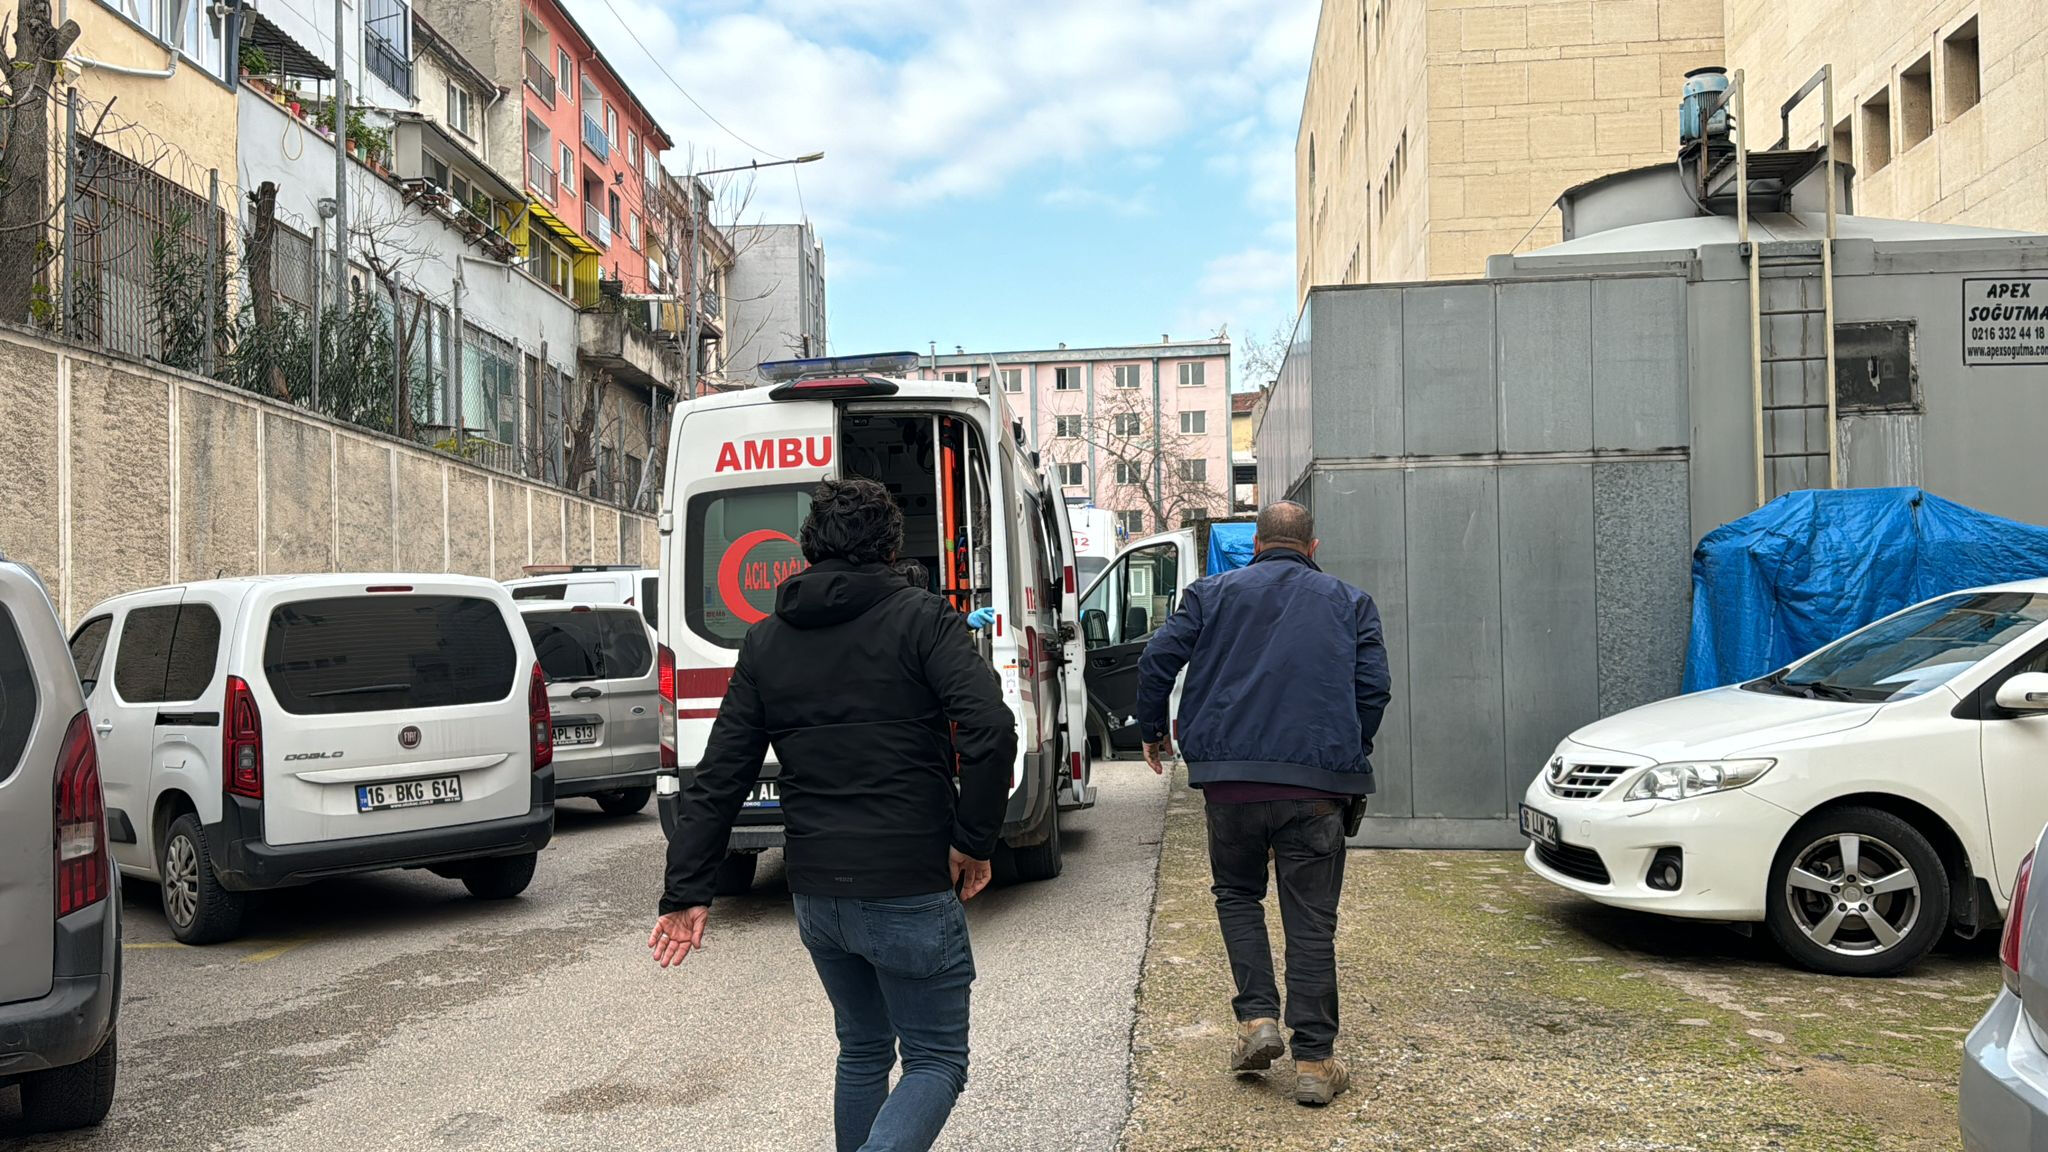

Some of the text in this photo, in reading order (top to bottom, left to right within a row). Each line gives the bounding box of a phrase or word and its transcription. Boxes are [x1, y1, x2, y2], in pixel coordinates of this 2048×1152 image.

[1987, 283, 2031, 298] APEX
[1972, 327, 2045, 340] 0216 332 44 18
[715, 436, 832, 472] AMBU
[575, 727, 593, 738] 613
[284, 751, 344, 761] DOBLO
[368, 787, 385, 805] 16
[396, 783, 424, 802] BKG
[432, 780, 457, 798] 614
